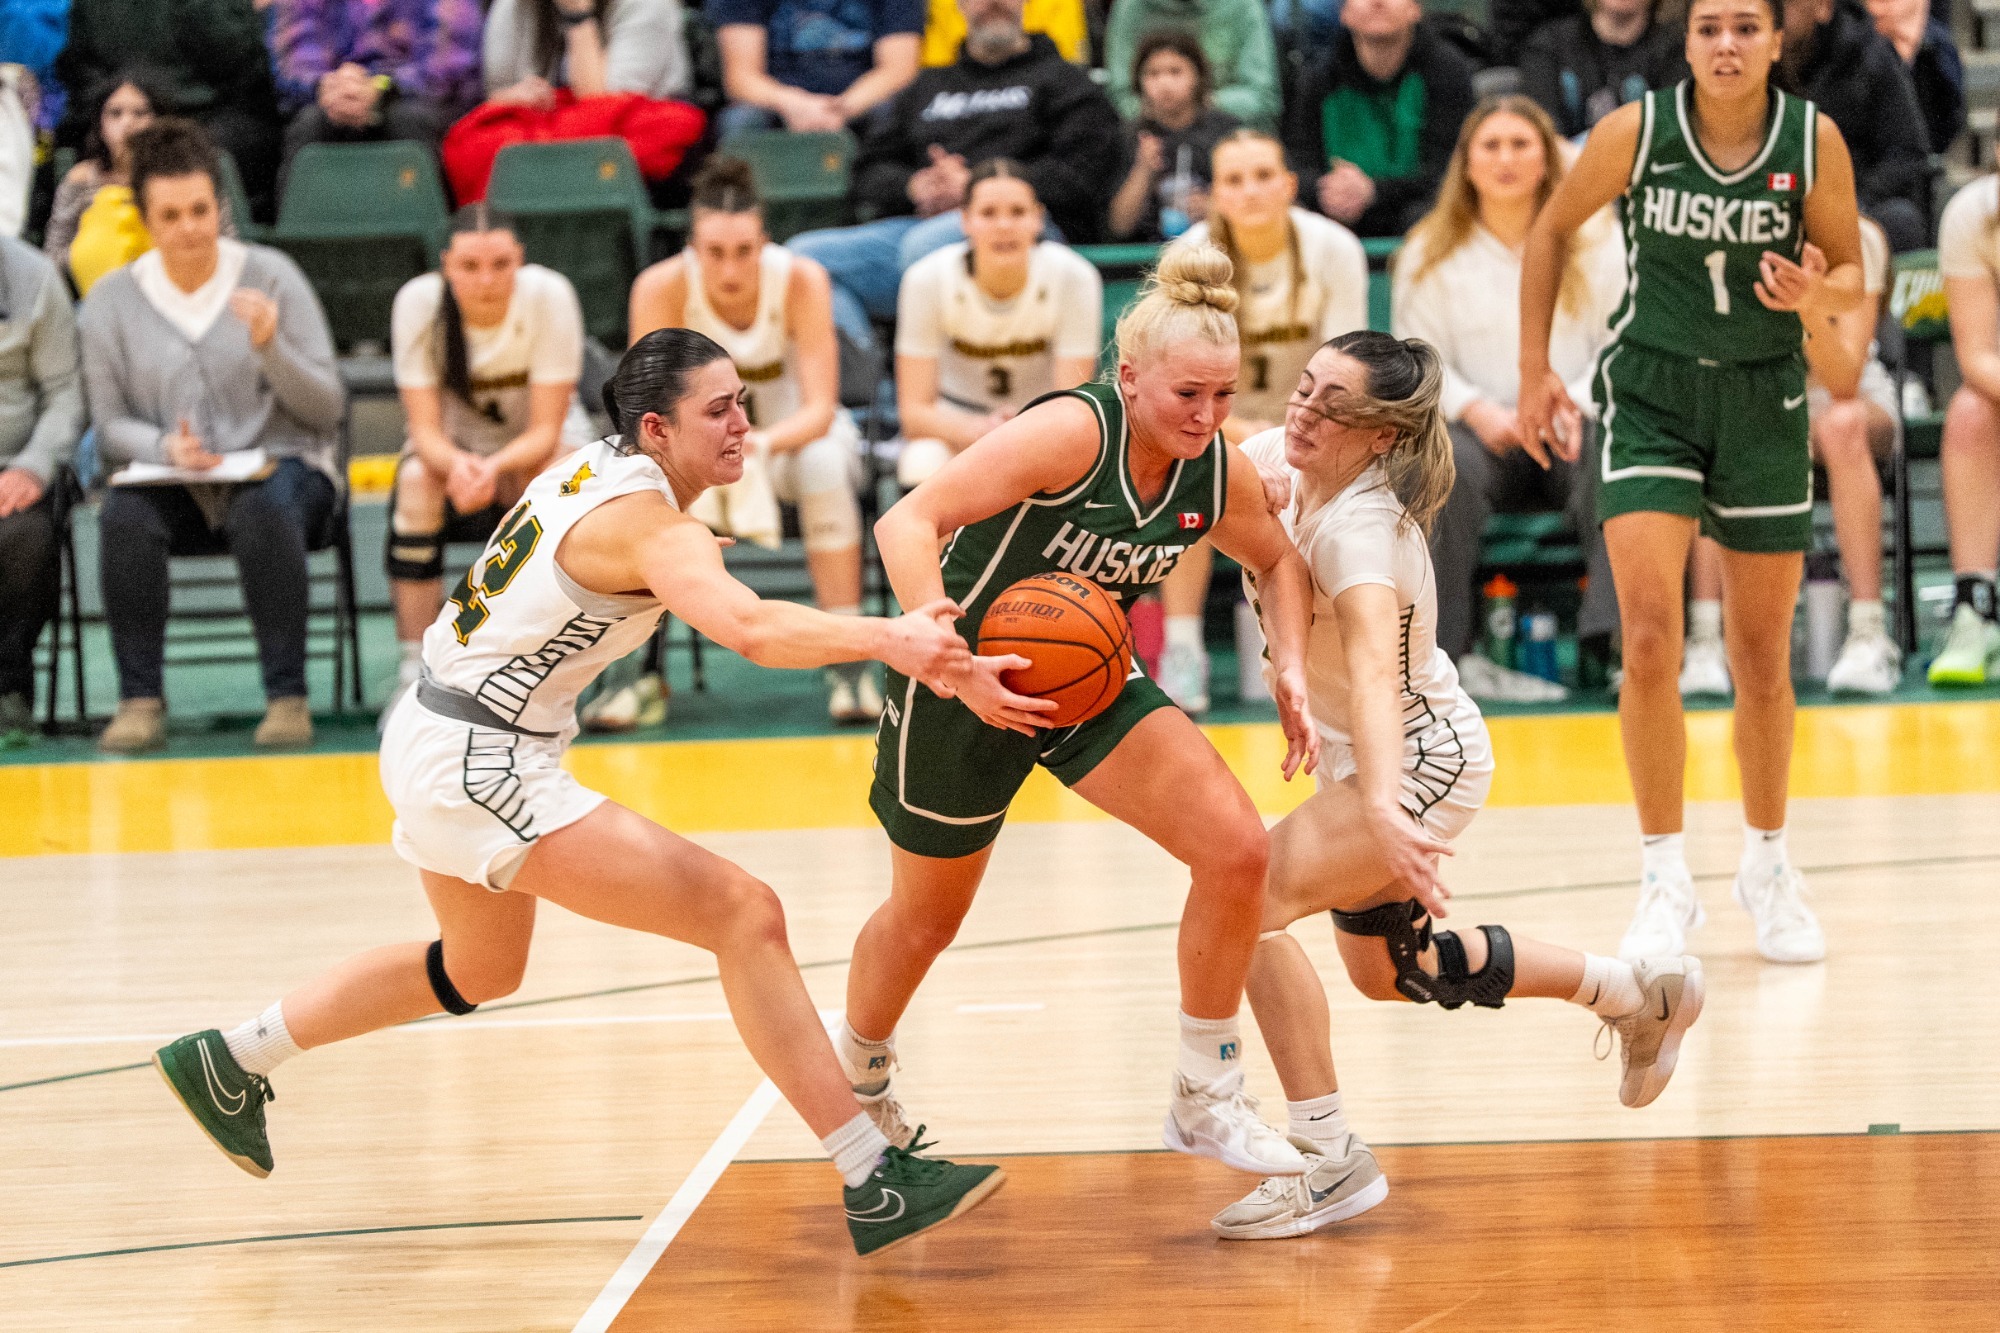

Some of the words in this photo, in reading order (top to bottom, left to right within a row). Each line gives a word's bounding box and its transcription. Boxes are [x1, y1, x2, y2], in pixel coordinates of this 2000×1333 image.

[1643, 185, 1791, 243] HUSKIES
[1704, 250, 1730, 315] 1
[1041, 520, 1194, 584] HUSKIE
